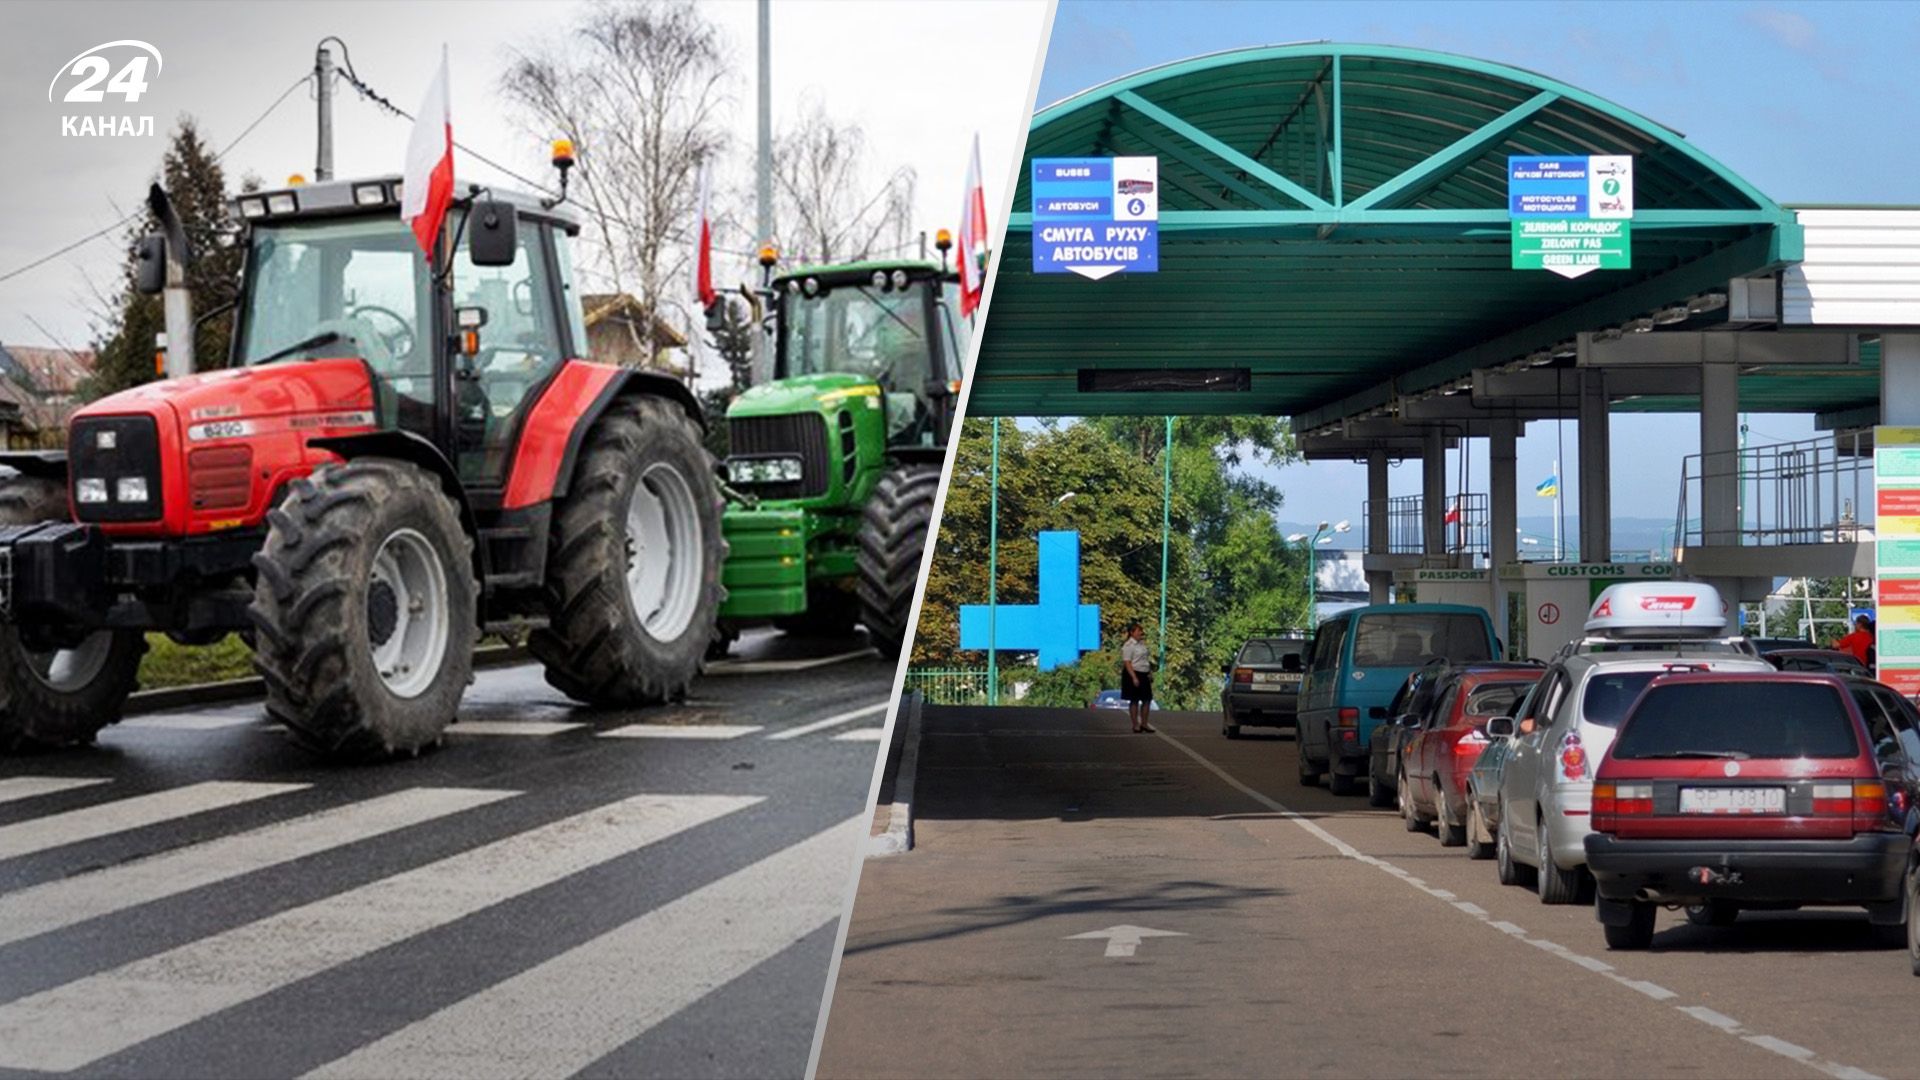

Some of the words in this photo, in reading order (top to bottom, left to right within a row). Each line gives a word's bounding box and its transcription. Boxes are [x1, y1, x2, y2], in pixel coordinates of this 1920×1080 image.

[1055, 168, 1091, 177] BUSES
[1607, 181, 1616, 193] 7
[1521, 195, 1577, 203] MOTOCYCLES
[1048, 202, 1099, 211] АВТОБУСИ
[1131, 200, 1141, 213] 6
[1042, 227, 1095, 242] СМУГА
[1106, 227, 1148, 241] РУХУ
[1541, 238, 1581, 249] ZIELONY
[1583, 238, 1602, 249] PAS
[1052, 246, 1138, 261] АВТОБУСІВ
[1542, 254, 1574, 265] GREEN
[1576, 254, 1601, 265] LANE
[1419, 571, 1486, 580] PASSPORT
[1547, 566, 1625, 576] CUSTOMS
[1695, 789, 1718, 807] RP
